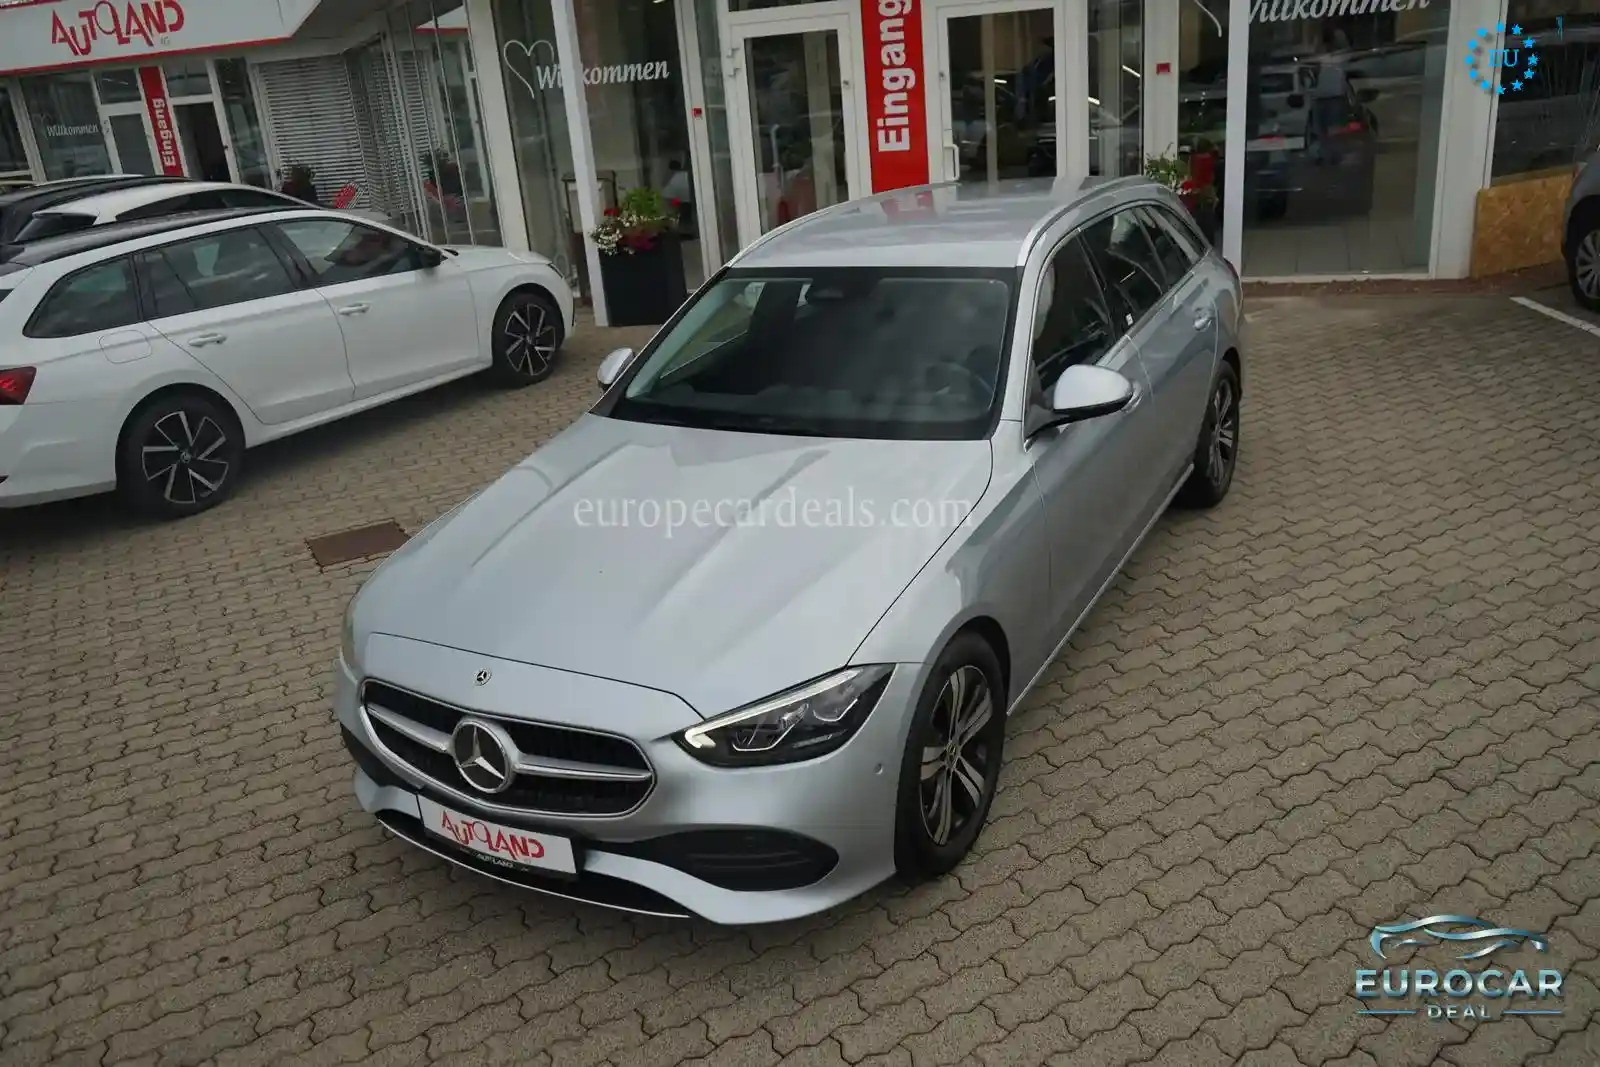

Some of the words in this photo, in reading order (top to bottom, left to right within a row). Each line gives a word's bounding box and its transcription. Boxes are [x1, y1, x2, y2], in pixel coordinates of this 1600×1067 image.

[52, 0, 184, 55] AUTOLAND
[536, 60, 670, 90] Wikommen
[877, 0, 916, 152] Eingang
[46, 123, 98, 137] Willkommen
[152, 98, 177, 166] Eingang
[441, 810, 545, 860] AUTOLAND
